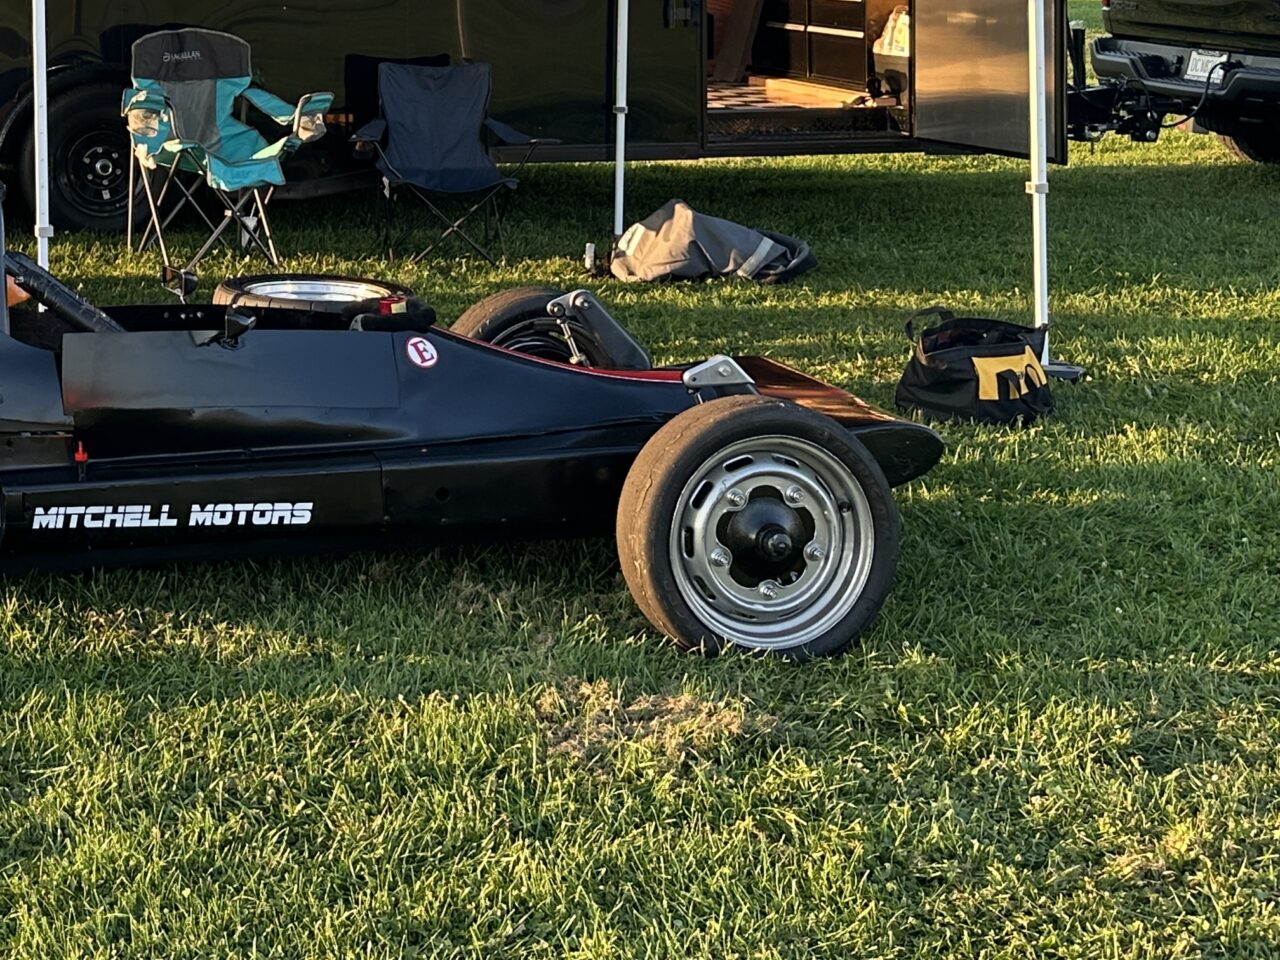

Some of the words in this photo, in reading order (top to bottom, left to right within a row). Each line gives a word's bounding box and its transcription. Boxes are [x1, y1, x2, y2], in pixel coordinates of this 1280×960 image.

[410, 340, 435, 364] E
[32, 504, 178, 530] MITCHELL
[189, 502, 314, 527] MOTORS
